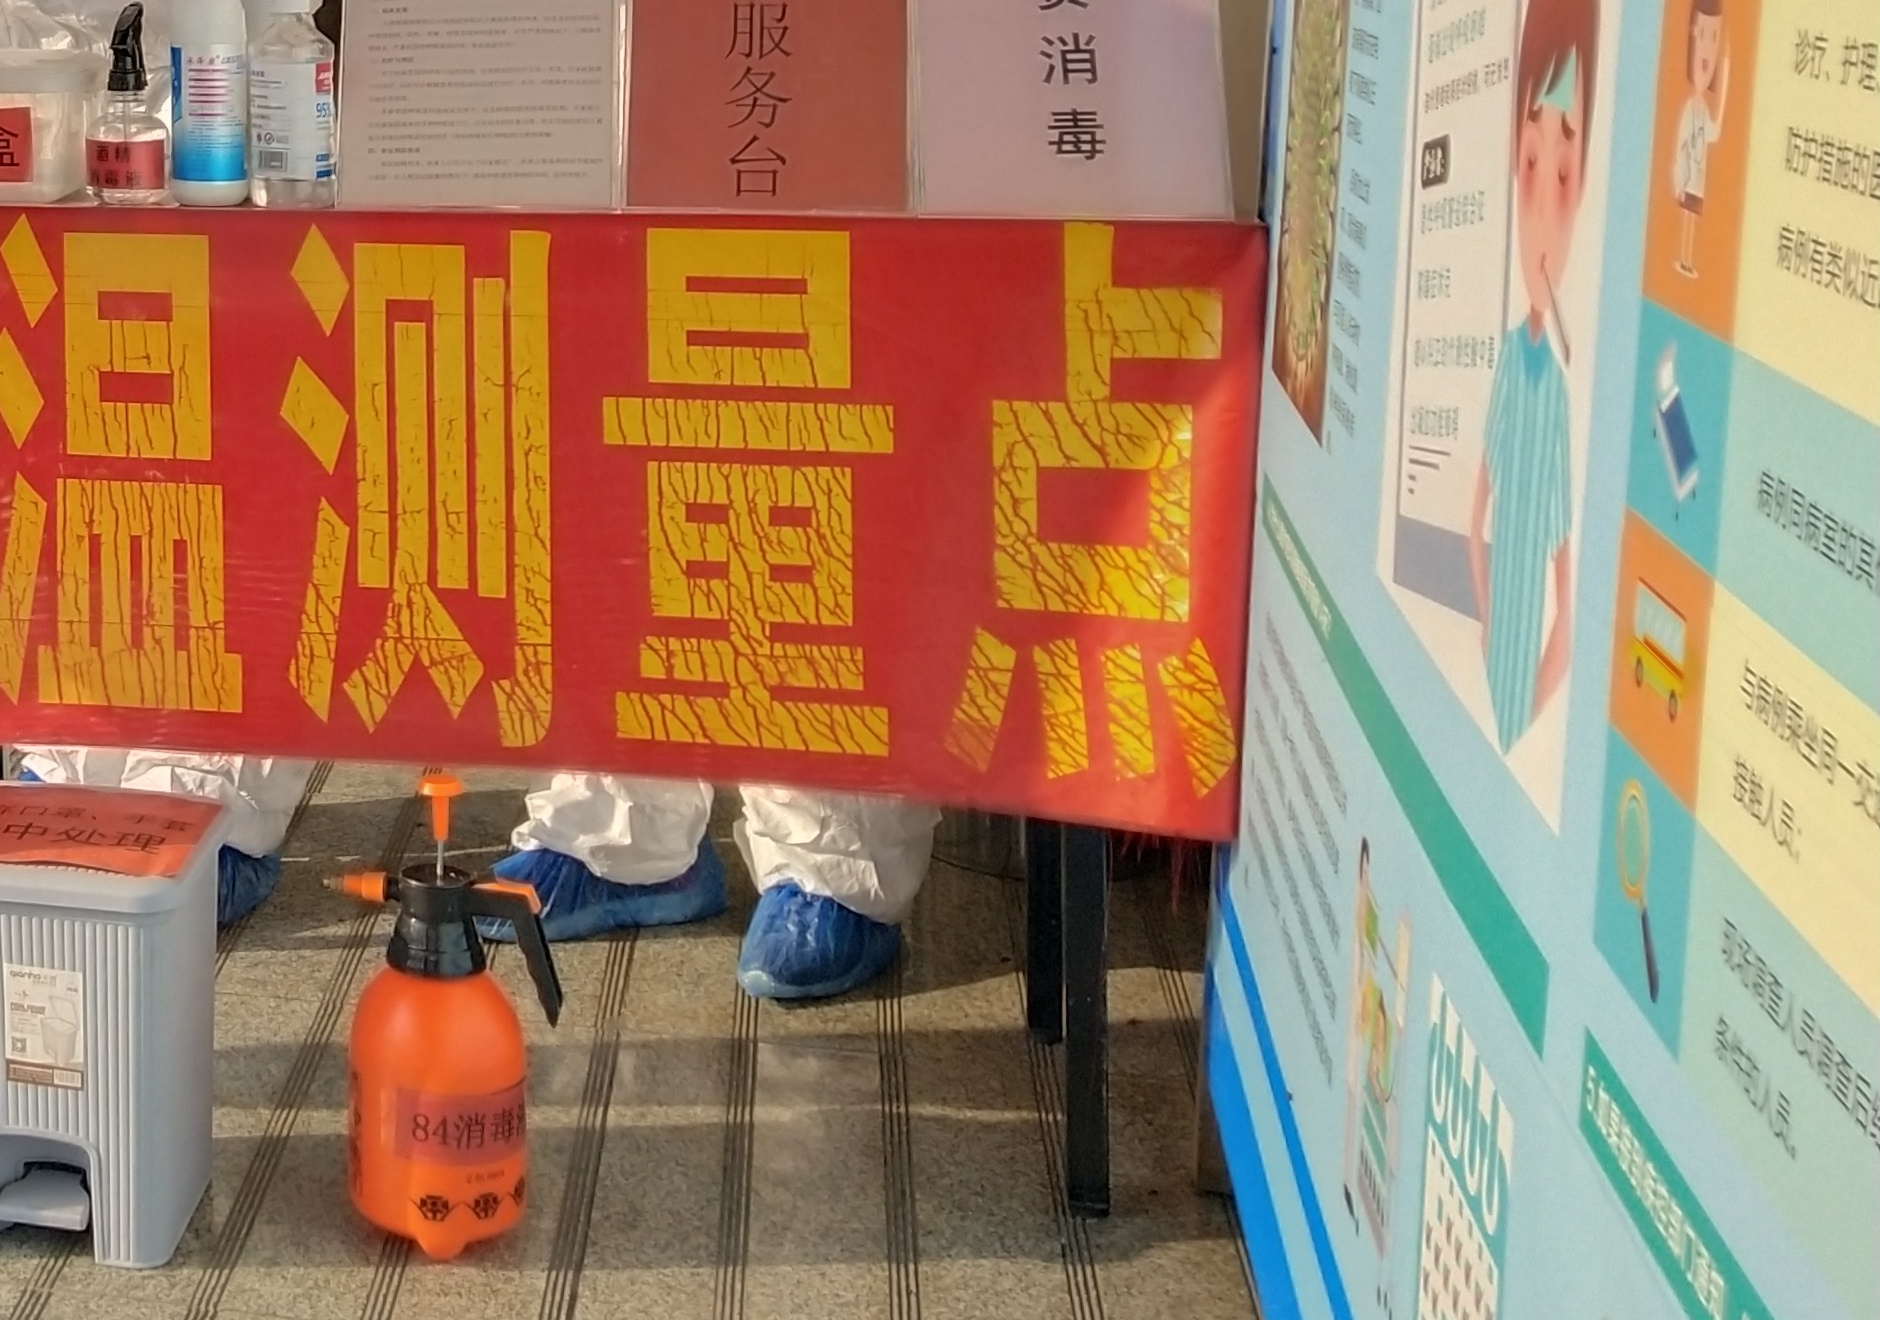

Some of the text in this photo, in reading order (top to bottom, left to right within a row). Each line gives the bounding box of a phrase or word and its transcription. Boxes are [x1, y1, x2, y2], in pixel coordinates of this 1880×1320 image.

[1776, 223, 1880, 310] 病例有类似近
